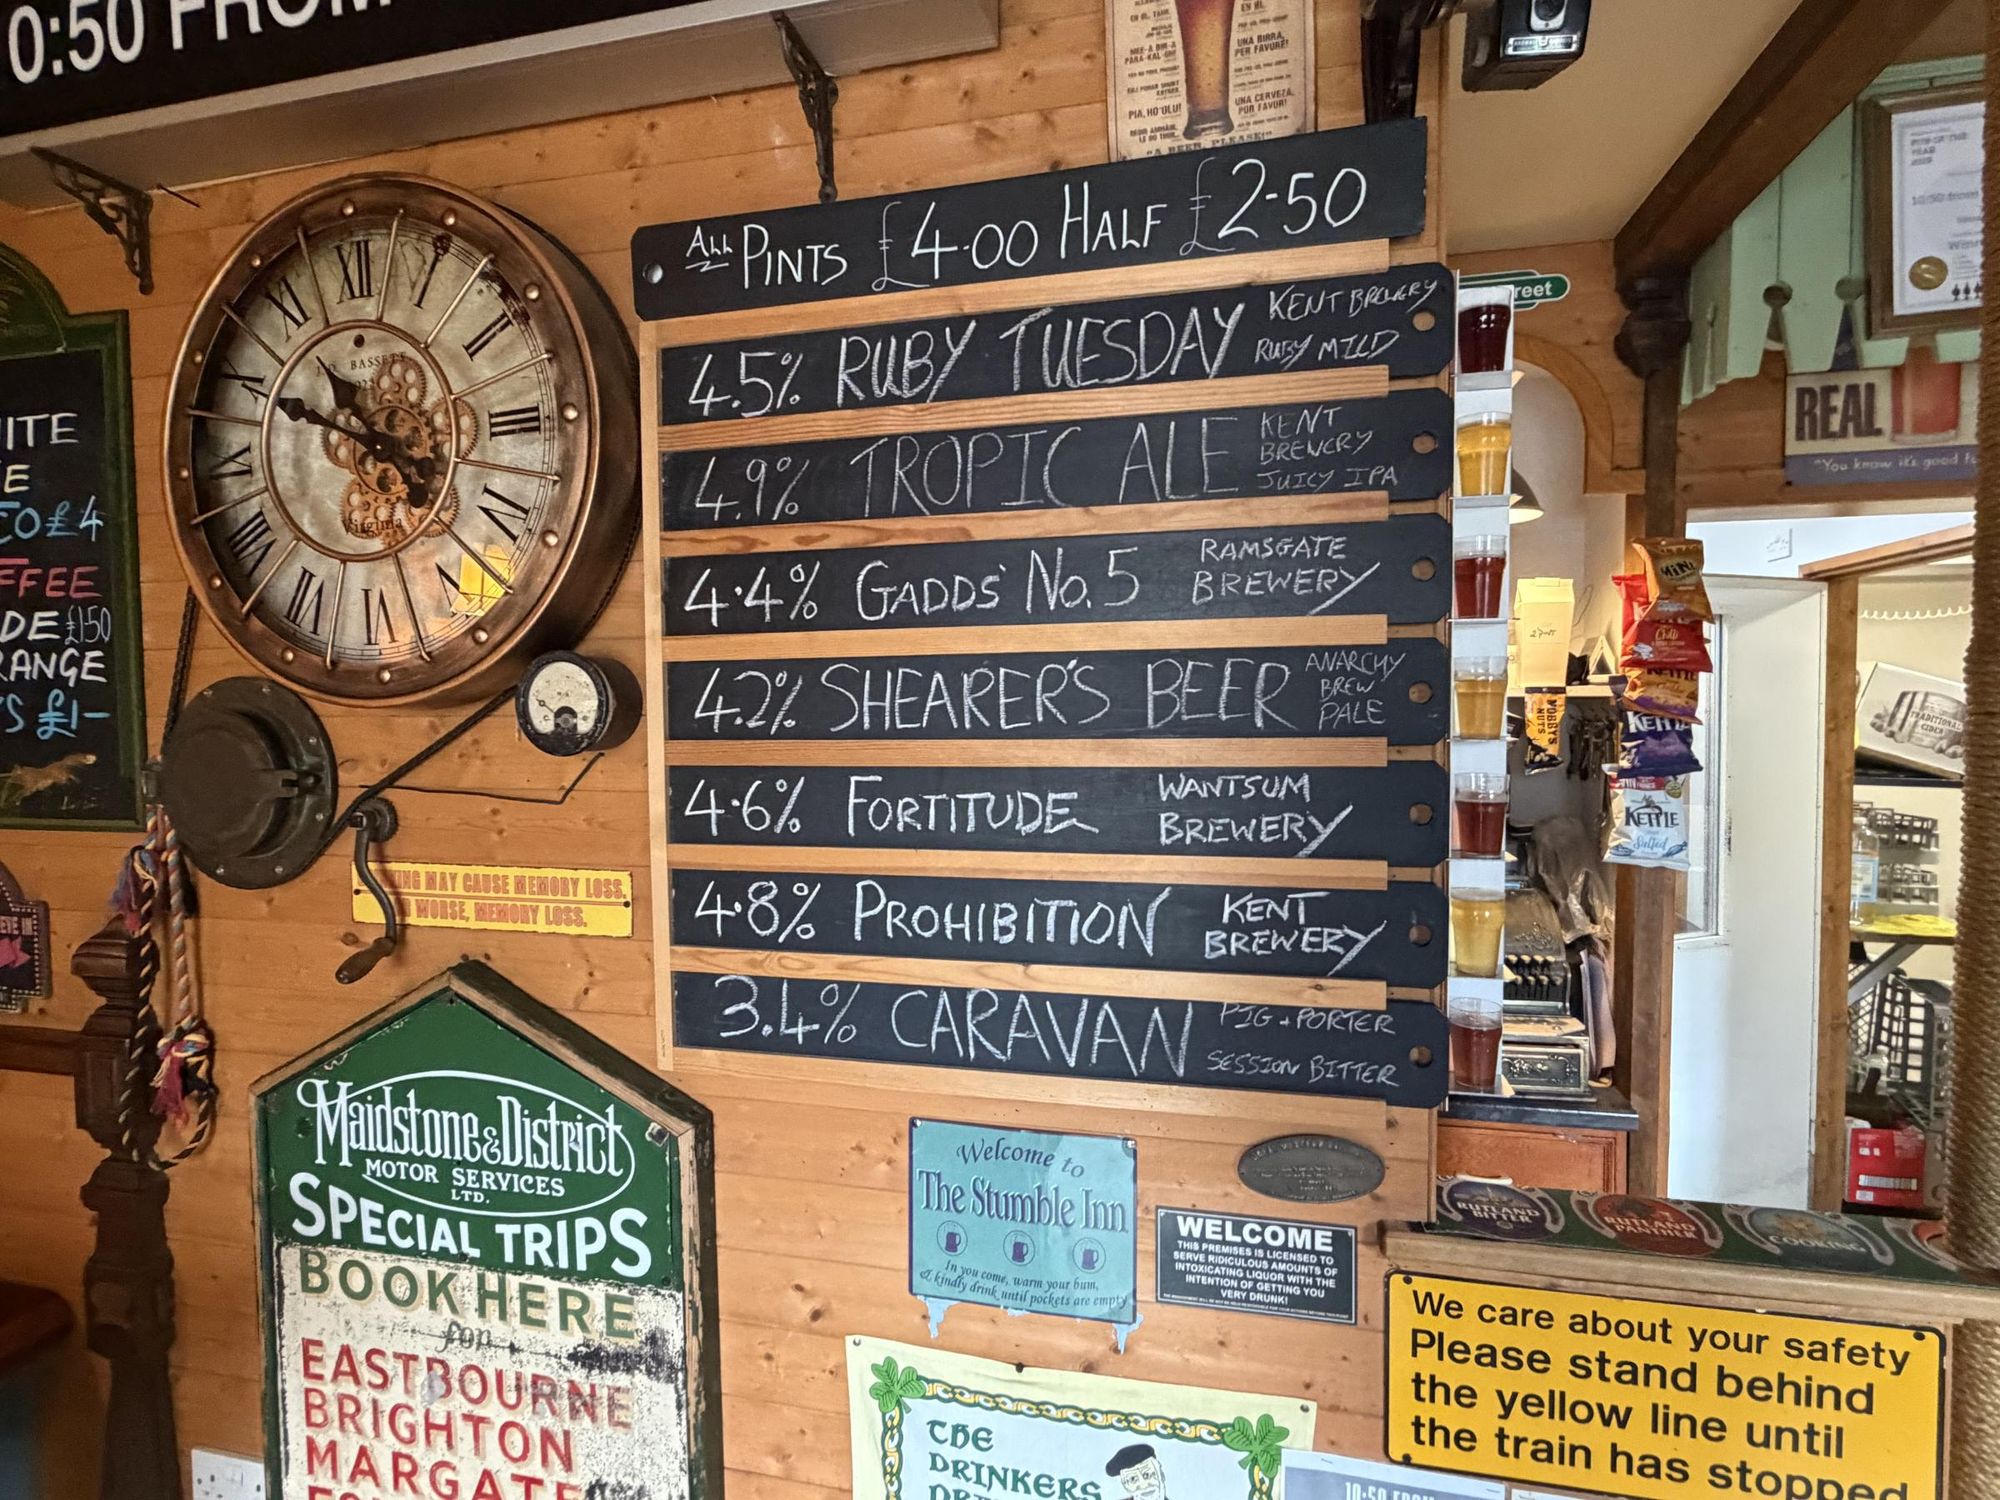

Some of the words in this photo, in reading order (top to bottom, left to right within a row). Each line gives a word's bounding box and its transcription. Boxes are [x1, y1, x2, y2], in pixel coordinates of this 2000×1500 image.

[743, 223, 848, 289] PINTS
[1060, 181, 1168, 259] HALF
[1269, 285, 1346, 322] KENT
[688, 351, 804, 418] 4.5%
[836, 320, 977, 408] RUBY
[999, 302, 1246, 391] TUESDAY
[1254, 334, 1314, 371] RUBY
[1318, 329, 1400, 361] MILD
[1260, 405, 1343, 438] KENT
[1795, 382, 1883, 442] REAL
[0, 413, 79, 451] ITE
[694, 456, 810, 522] 4.9%
[850, 427, 1082, 518] TROPIC
[1118, 416, 1239, 504] ALE
[1256, 469, 1336, 493] JUICY
[1343, 465, 1398, 488] IPA
[1853, 457, 1893, 470] know
[1923, 454, 1959, 471] good
[1201, 536, 1348, 563] RAMSGATE
[684, 560, 822, 627] 4.4%
[1026, 547, 1092, 614] No.
[1104, 546, 1140, 607] 5
[1192, 562, 1381, 616] BREWERY
[1304, 651, 1407, 682] ANARCHY
[694, 667, 803, 735] 4.2%
[820, 660, 1110, 733] SHEARER'S
[1147, 658, 1299, 730] BEER
[1320, 677, 1376, 697] BREW
[1318, 700, 1387, 731] PALE
[1536, 707, 1546, 735] NUTS
[1158, 772, 1312, 802] WANTSUM
[684, 776, 805, 836] 4.6%
[847, 774, 1099, 838] FORTITUDE
[1625, 804, 1680, 828] KETTLE
[1159, 803, 1354, 858] BREWERY
[424, 871, 458, 892] MAY
[462, 873, 511, 894] CAUSE
[514, 875, 580, 898] MEMORY
[585, 878, 628, 900] LOSS.
[475, 902, 539, 925] MEMORY
[545, 905, 588, 928] LOSS.
[694, 881, 821, 943] 4.8%
[853, 879, 1173, 958] PROHIBITION
[1221, 891, 1331, 925] KENT
[1204, 920, 1388, 977] BREWERY
[714, 974, 861, 1046] 3.4%
[891, 988, 1194, 1078] CARAVAN
[1296, 1007, 1396, 1035] PORTER
[1206, 1050, 1301, 1076] SESSION
[1307, 1055, 1400, 1087] BITTER
[296, 1077, 479, 1168] Maidstone
[497, 1094, 624, 1176] District
[956, 1137, 1056, 1167] Welcome
[1061, 1157, 1085, 1179] to
[364, 1158, 440, 1184] MOTOR
[452, 1166, 566, 1198] SERVICES
[451, 1188, 490, 1205] LTD.
[916, 1168, 966, 1214] The
[970, 1175, 1075, 1229] Stumble
[1080, 1187, 1129, 1234] Inn
[1456, 1201, 1541, 1218] RUTLAND
[1472, 1211, 1533, 1224] BITTER
[289, 1171, 482, 1258] SPECIAL
[495, 1207, 652, 1278] TRIPS
[1176, 1215, 1333, 1252] WELCOME
[1603, 1215, 1697, 1232] RUTLAND
[1614, 1224, 1698, 1239] PANTHER
[1173, 1251, 1206, 1263] SERVE
[1207, 1254, 1269, 1270] RIDICULOUS
[1271, 1261, 1322, 1276] AMOUNTS
[1324, 1267, 1338, 1277] OF
[1177, 1240, 1200, 1251] THIS
[1201, 1243, 1252, 1257] PREMISES
[1254, 1248, 1264, 1258] IS
[1266, 1250, 1317, 1264] LICENSED
[1320, 1255, 1334, 1265] TO
[934, 1271, 968, 1292] kindly
[969, 1280, 999, 1298] drink
[1001, 1289, 1028, 1304] until
[1029, 1292, 1070, 1308] pockets
[944, 1260, 957, 1274] In
[959, 1265, 979, 1281] you
[1013, 1276, 1043, 1290] warm
[1046, 1280, 1070, 1294] your
[1175, 1262, 1244, 1278] INTOXICATING
[1246, 1269, 1285, 1283] LIQUOR
[1287, 1273, 1313, 1286] WITH
[1315, 1277, 1337, 1288] THE
[1185, 1274, 1238, 1289] INTENTION
[1240, 1279, 1253, 1290] OF
[1256, 1282, 1301, 1296] GETTING
[1303, 1286, 1325, 1298] YOU
[300, 1250, 460, 1319] BOOK
[477, 1272, 636, 1341] HERE
[1220, 1289, 1247, 1300] VERY
[1249, 1292, 1289, 1305] DRUNK!
[1411, 1289, 1464, 1321] We
[1477, 1301, 1555, 1330] care
[1568, 1310, 1672, 1346] about
[1687, 1326, 1770, 1355] your
[1783, 1336, 1911, 1377] safety
[302, 1337, 634, 1430] EASTBOURNE
[1410, 1327, 1552, 1374] Please
[1568, 1349, 1698, 1395] stand
[1716, 1364, 1876, 1416] behind
[304, 1387, 574, 1474] BRIGHTON
[1411, 1371, 1478, 1409] the
[1495, 1388, 1633, 1430] yellow
[1650, 1402, 1728, 1444] line
[1746, 1420, 1845, 1460] until
[1411, 1414, 1478, 1453] the
[1494, 1426, 1593, 1470] train
[1609, 1442, 1691, 1484] has
[928, 1451, 1102, 1500] DRINKERS
